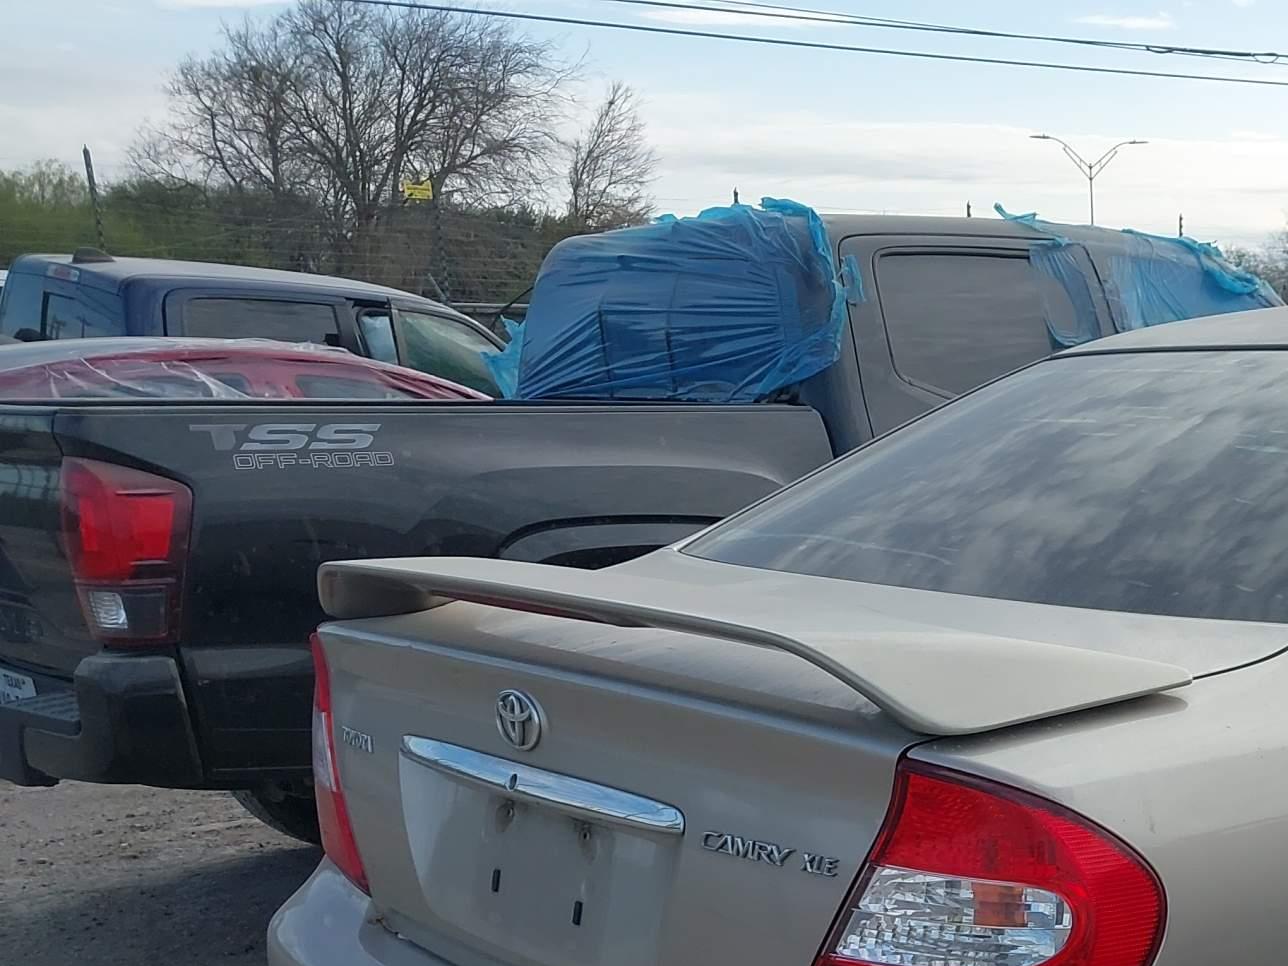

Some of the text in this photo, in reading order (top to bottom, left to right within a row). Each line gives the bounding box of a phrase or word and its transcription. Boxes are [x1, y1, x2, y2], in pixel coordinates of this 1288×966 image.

[188, 423, 382, 450] TSS
[232, 451, 395, 470] OFF-ROAD
[702, 831, 840, 877] CAMRY XLE
